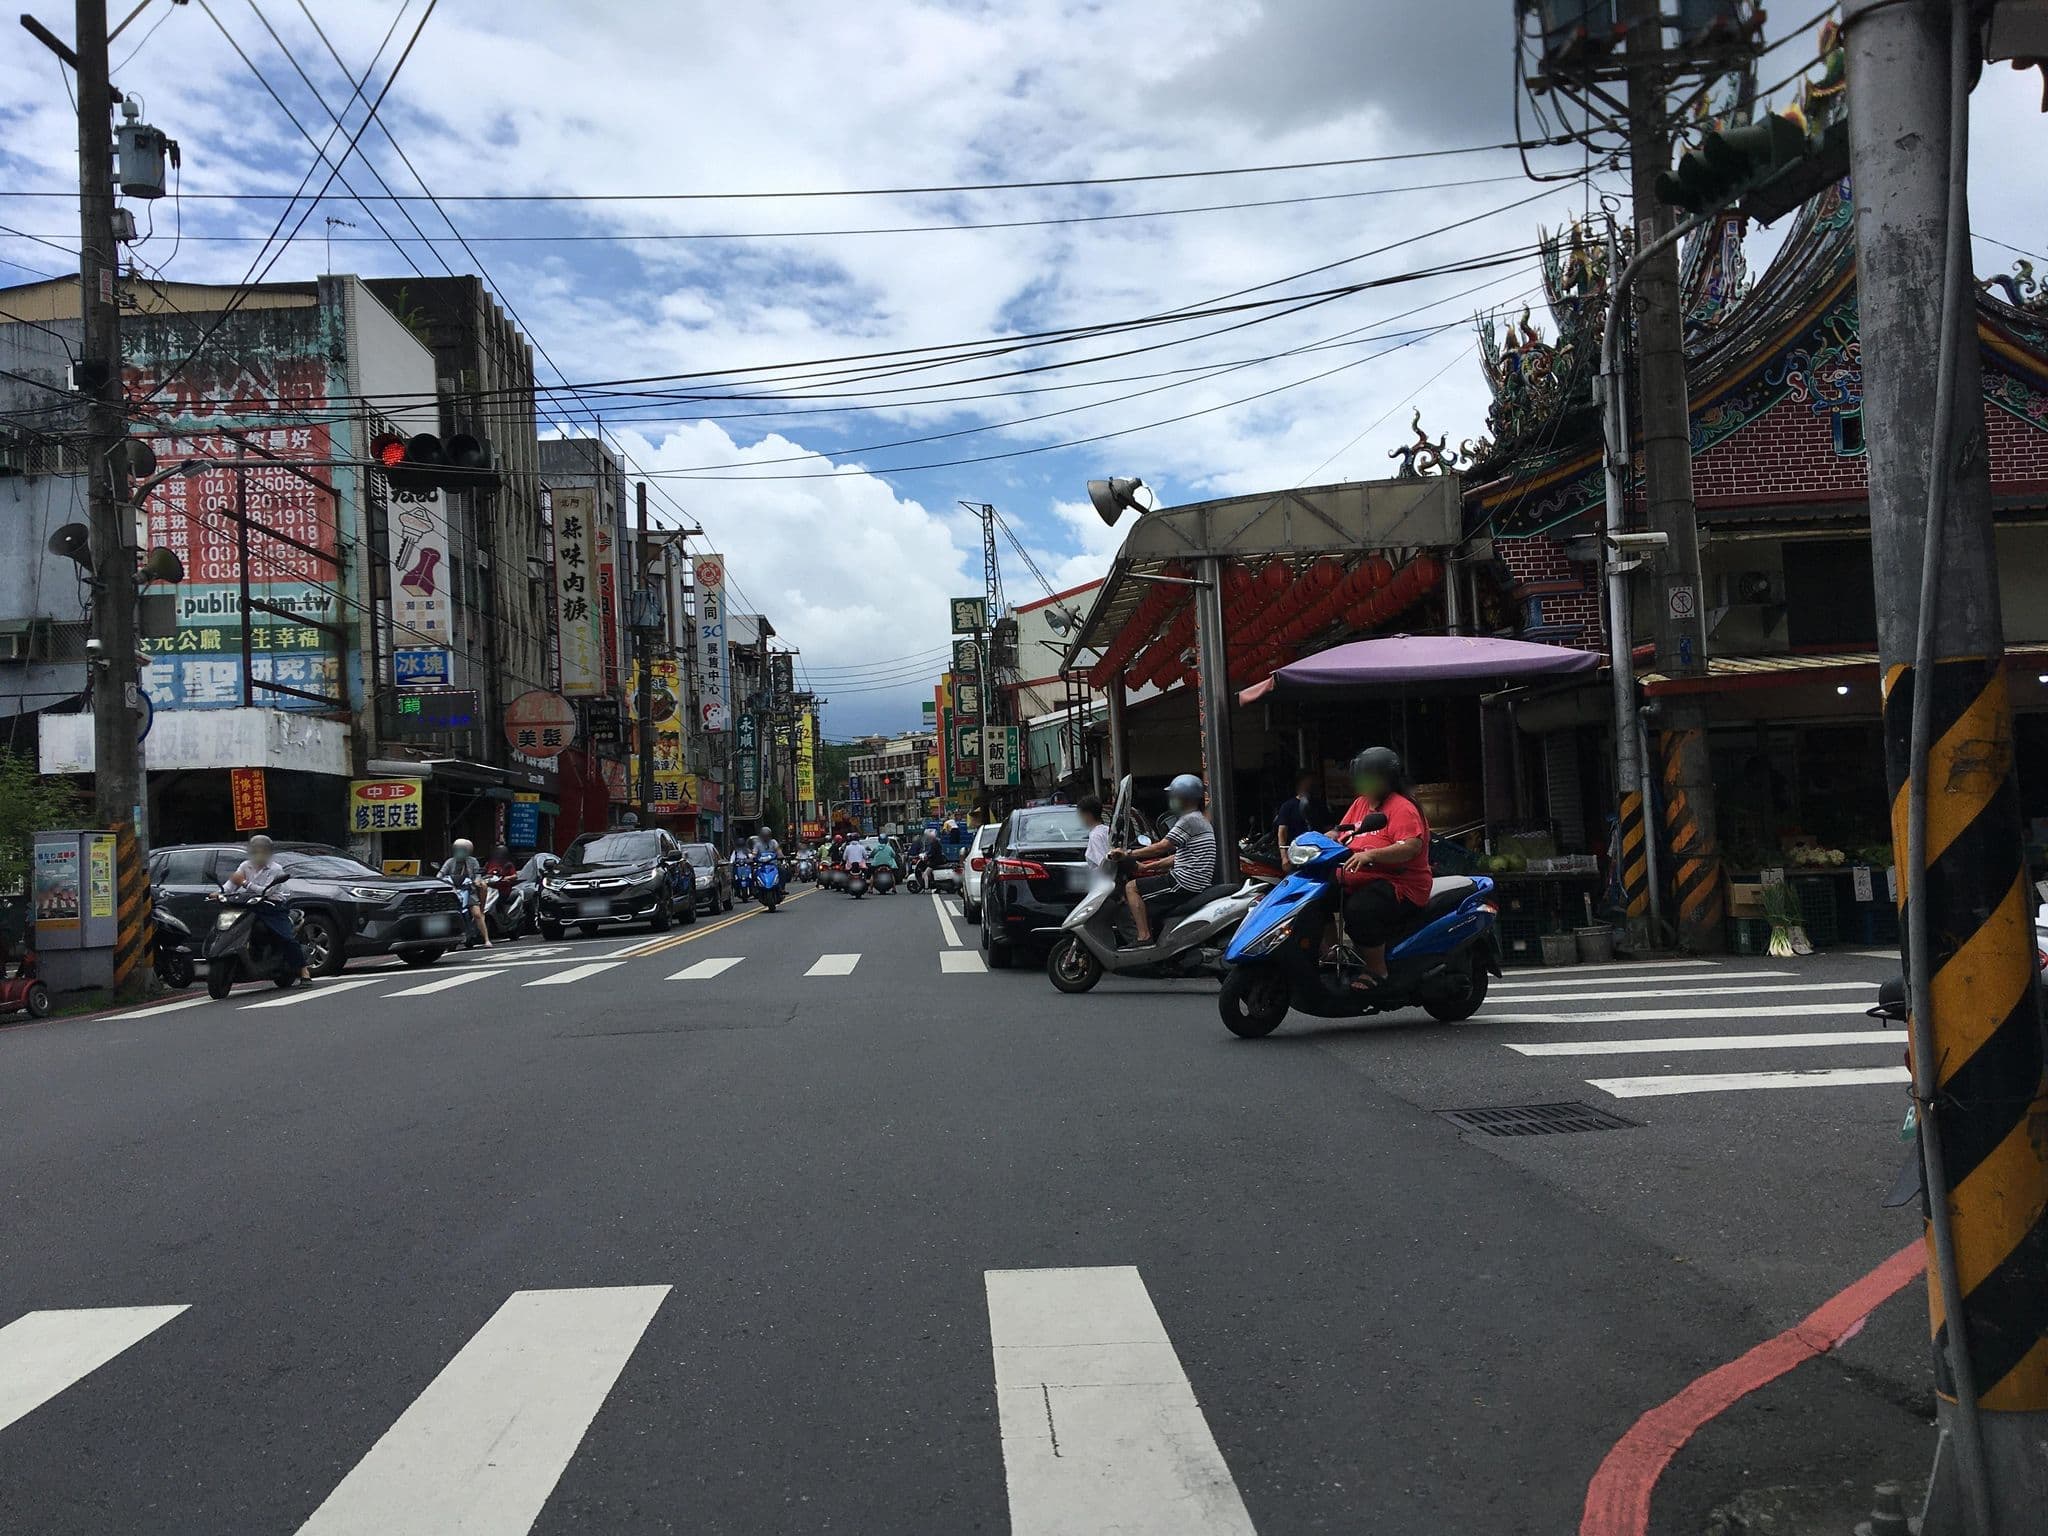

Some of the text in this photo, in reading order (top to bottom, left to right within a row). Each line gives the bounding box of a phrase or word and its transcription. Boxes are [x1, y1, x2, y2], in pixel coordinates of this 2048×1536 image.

[397, 655, 445, 675] 冰塊
[518, 728, 562, 748] 美髮
[988, 742, 1005, 780] 飯糰
[367, 785, 405, 798] 中正
[355, 802, 418, 830] 修理皮鞋
